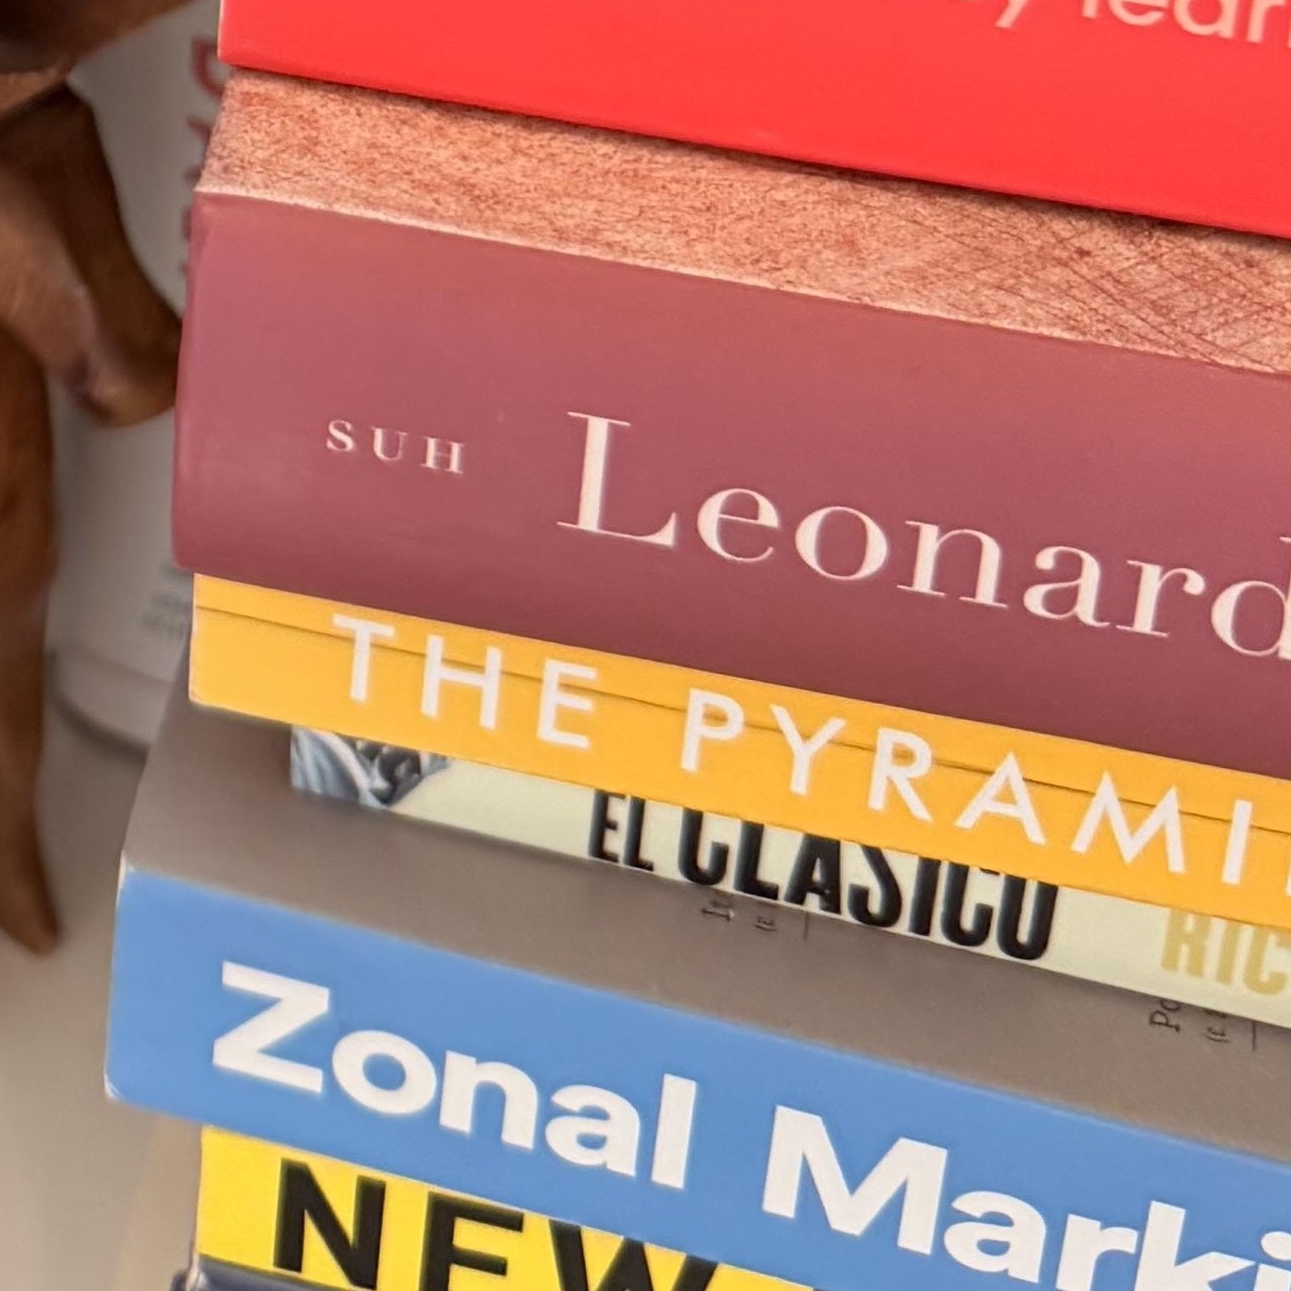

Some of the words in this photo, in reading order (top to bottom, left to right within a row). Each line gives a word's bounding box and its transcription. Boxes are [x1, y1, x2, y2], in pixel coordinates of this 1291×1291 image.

[325, 419, 465, 475] SUH
[556, 410, 1291, 661] Leonard
[332, 614, 597, 749] THE
[680, 686, 1291, 886] PYRAMI
[213, 961, 698, 1189] Zonal
[273, 1158, 719, 1291] NEW
